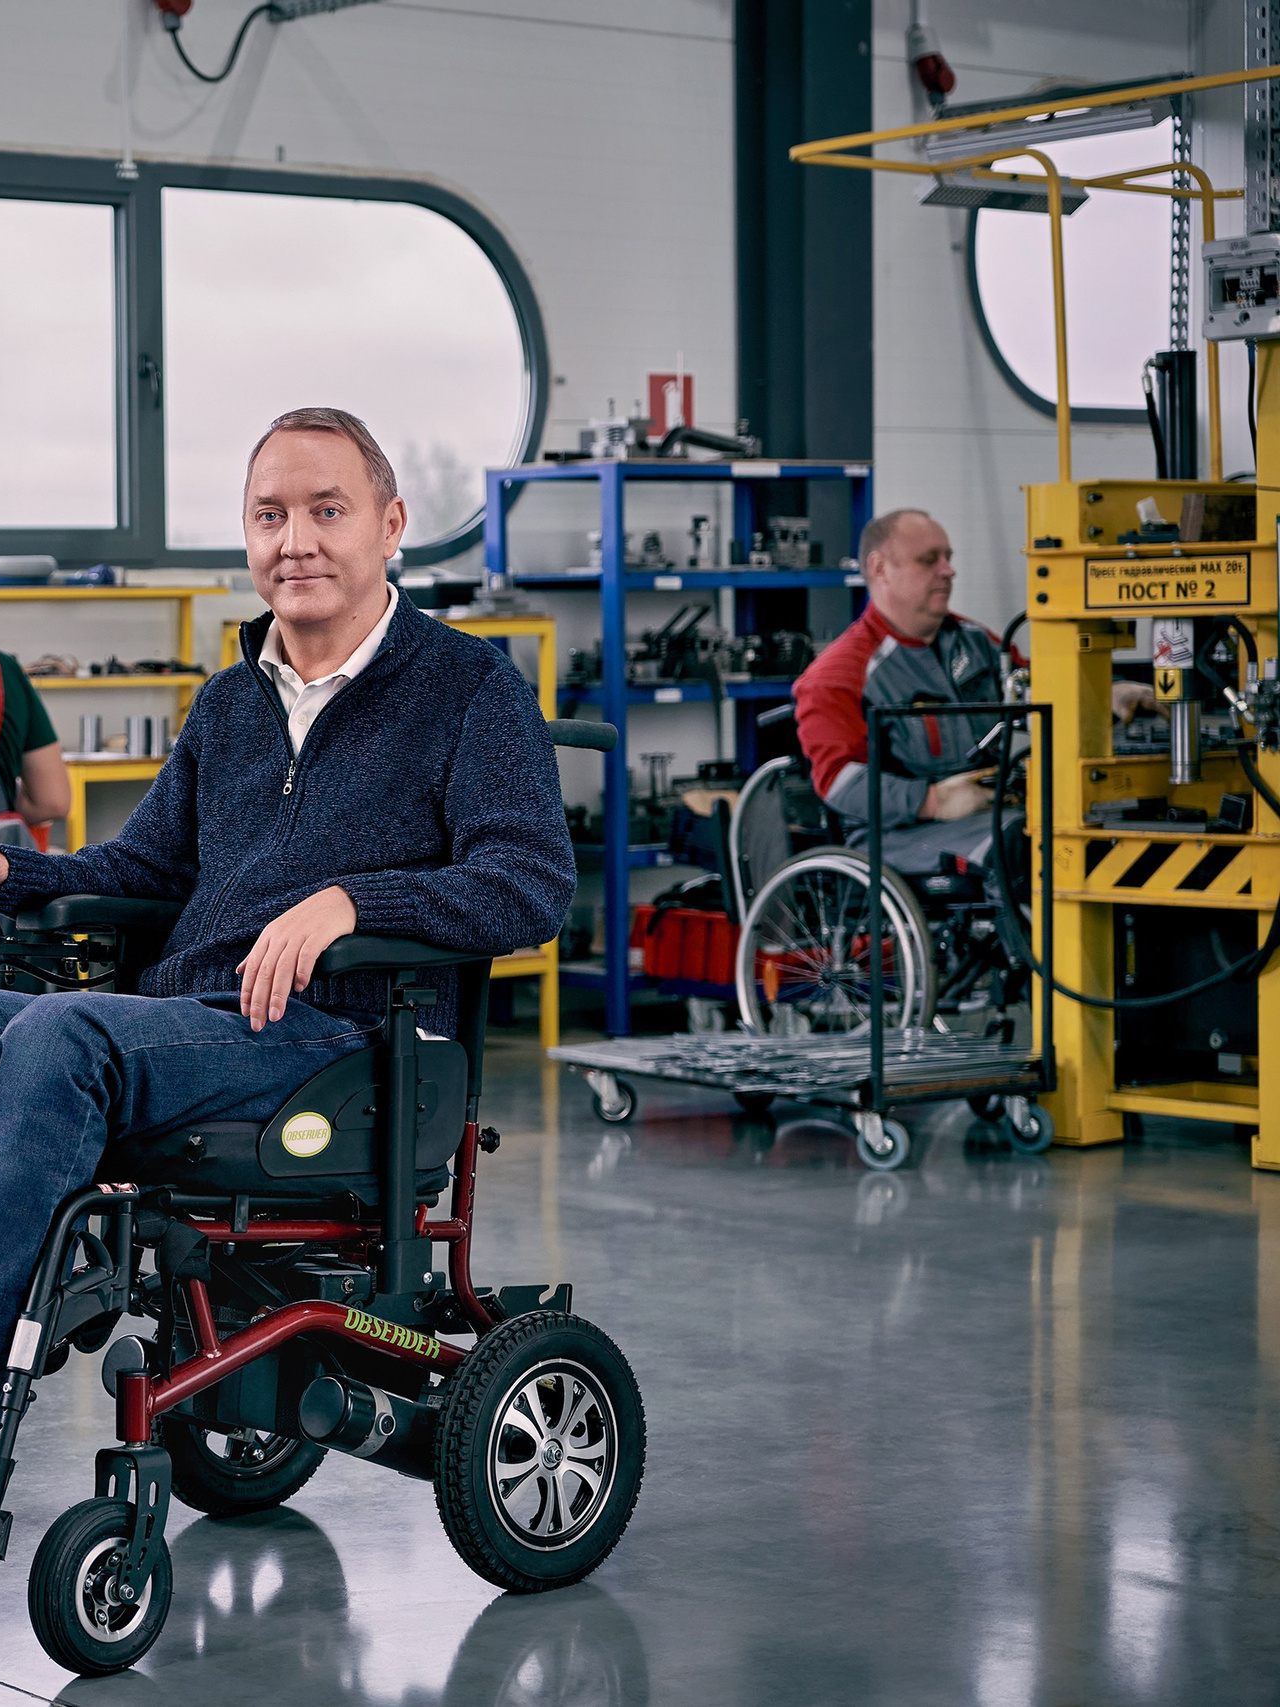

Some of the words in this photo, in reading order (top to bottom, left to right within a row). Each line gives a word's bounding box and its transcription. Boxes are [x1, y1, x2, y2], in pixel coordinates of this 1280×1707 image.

[1090, 565, 1116, 578] Пресс
[1119, 563, 1197, 578] гидравлический
[1118, 580, 1170, 600] ПОСТ
[1176, 580, 1199, 599] №
[1204, 579, 1217, 599] 2
[286, 1128, 328, 1142] OBSERVER
[344, 1308, 441, 1360] OBSERVER
